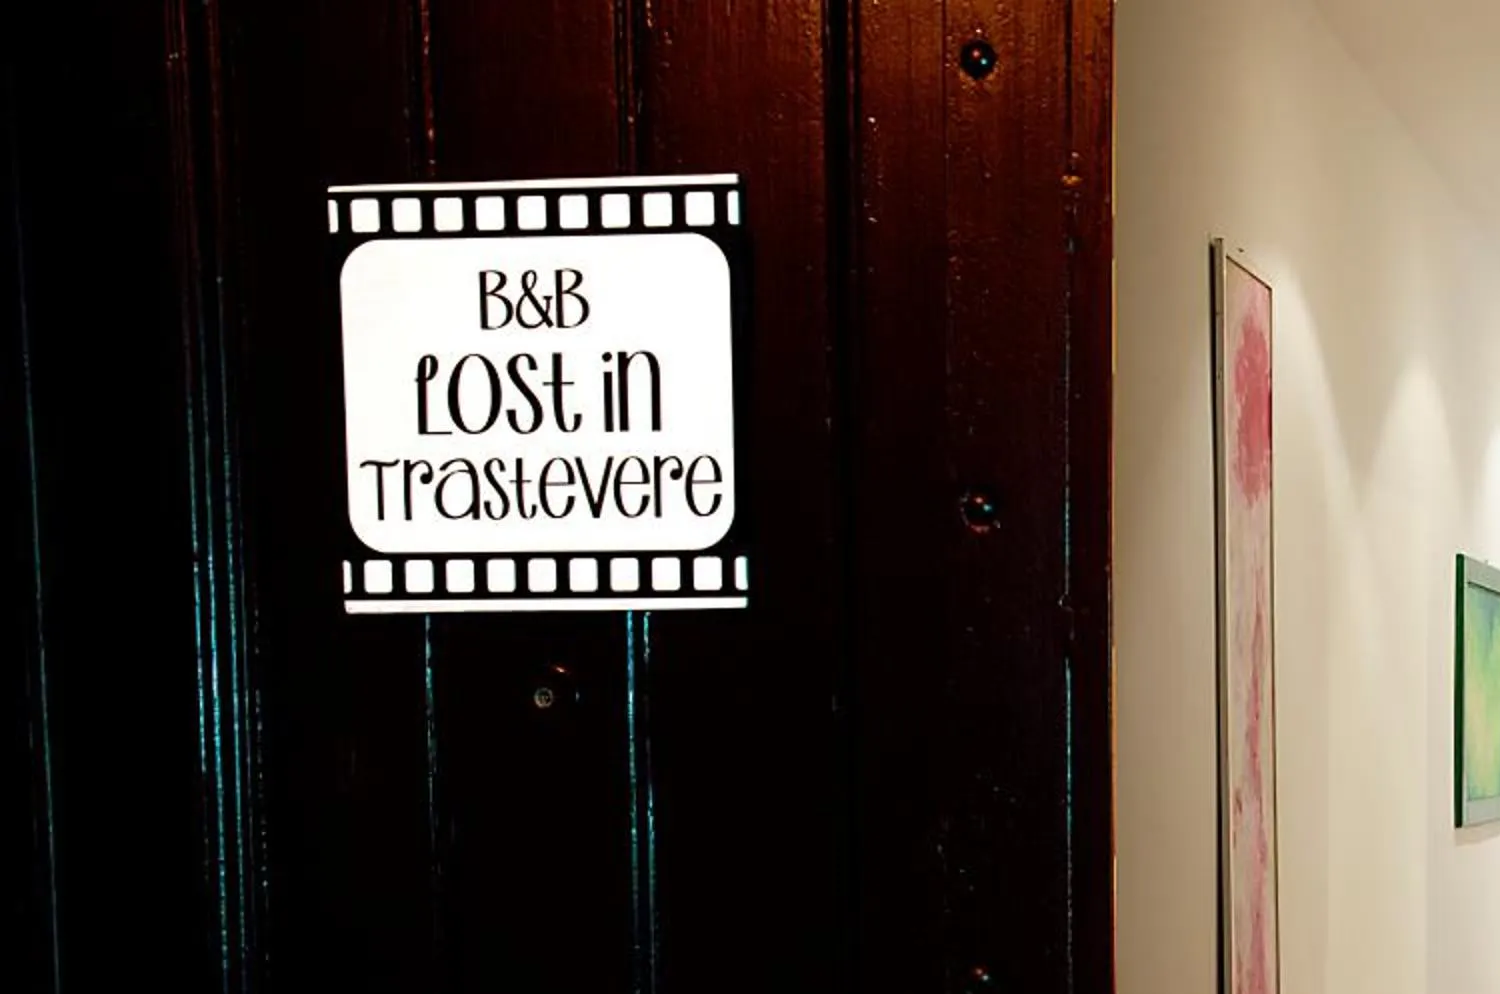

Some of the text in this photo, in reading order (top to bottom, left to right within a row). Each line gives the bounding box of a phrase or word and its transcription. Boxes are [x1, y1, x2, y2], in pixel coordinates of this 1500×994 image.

[479, 269, 590, 330] B&B
[601, 350, 662, 433] in
[359, 455, 723, 521] Trastevere
